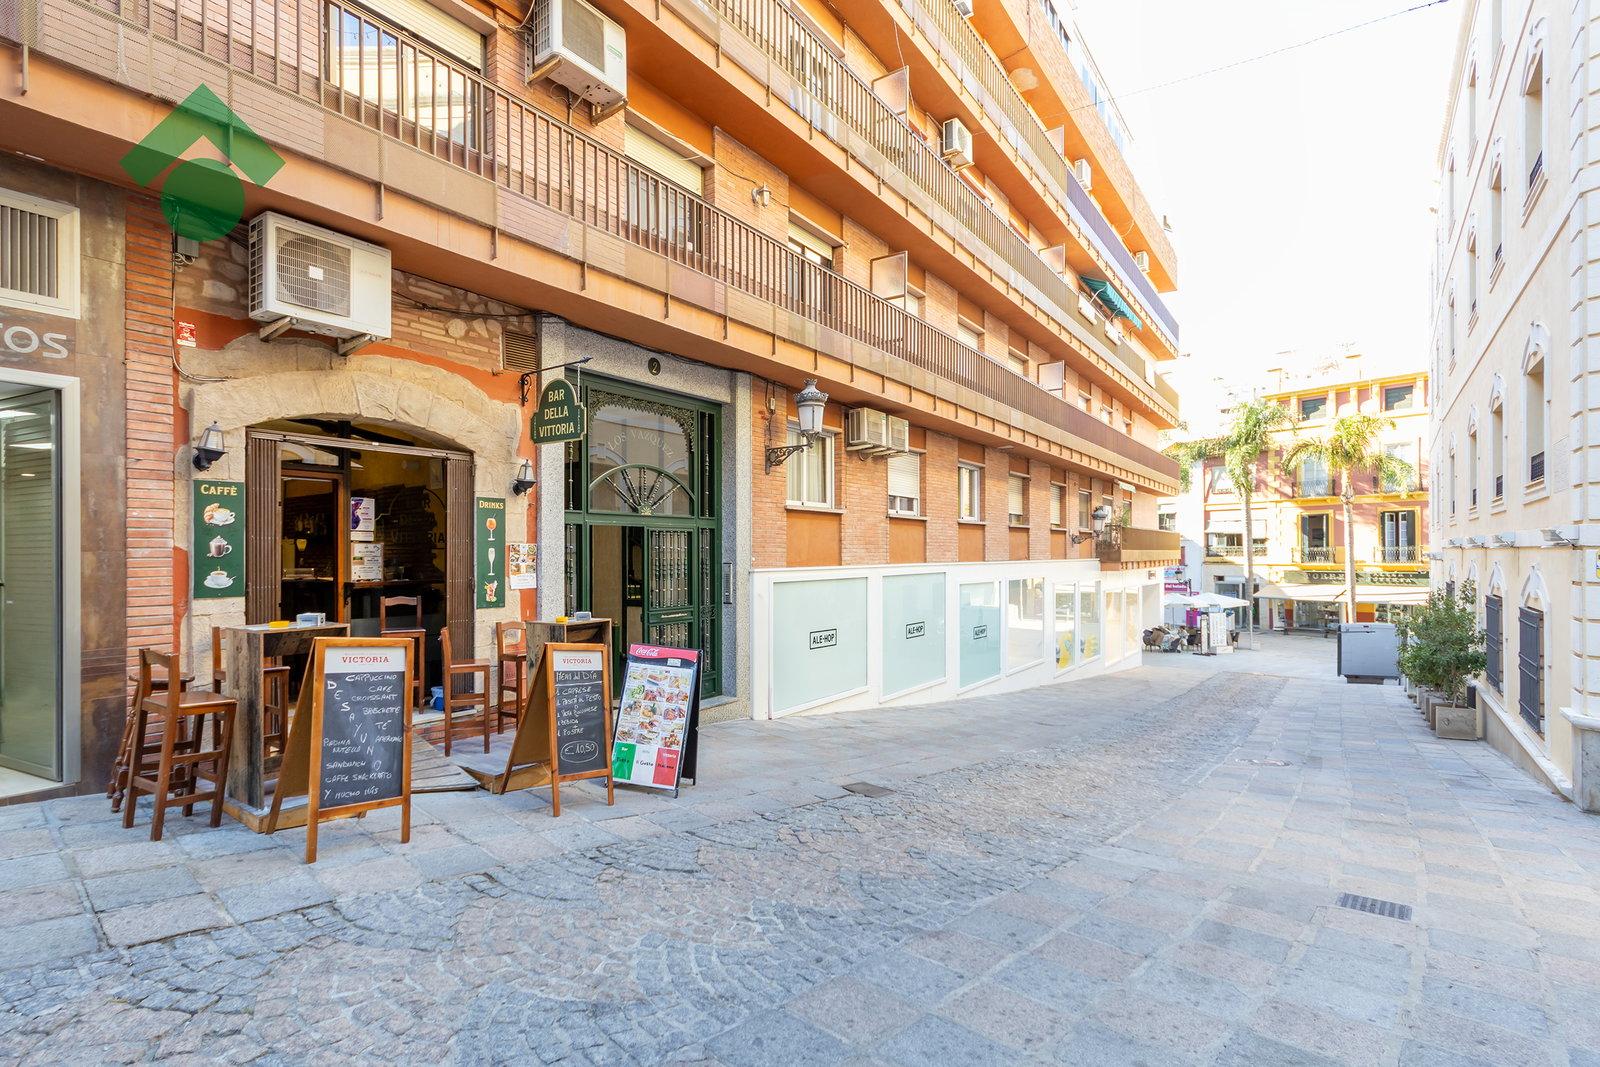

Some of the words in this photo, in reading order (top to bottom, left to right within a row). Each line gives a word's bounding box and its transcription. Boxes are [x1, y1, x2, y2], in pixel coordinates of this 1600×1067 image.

[0, 323, 69, 359] OS
[651, 361, 658, 373] 2
[548, 388, 565, 402] BAR
[544, 406, 569, 420] DELLA
[539, 422, 575, 438] VITTORIA
[608, 432, 627, 450] LOS
[200, 484, 238, 496] CAFFÈ
[479, 501, 504, 510] DRINKS
[342, 656, 389, 664] VICTORIA
